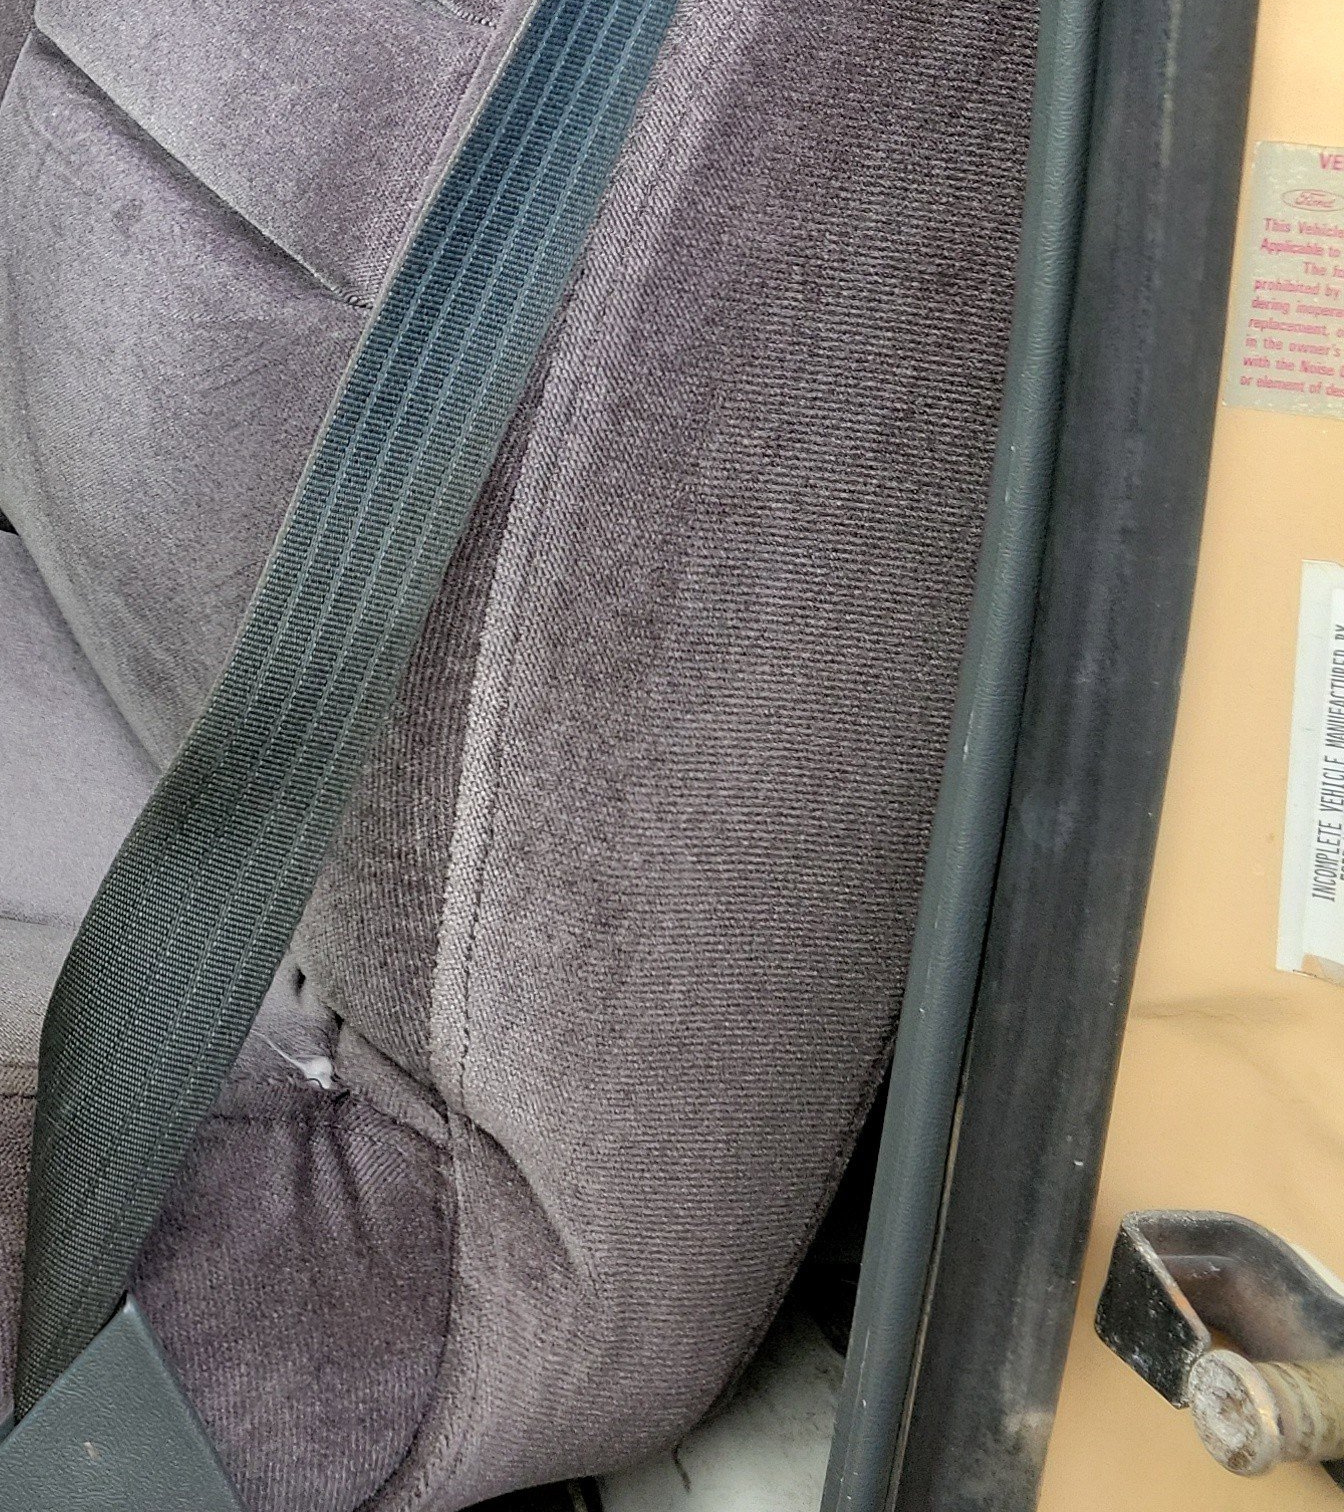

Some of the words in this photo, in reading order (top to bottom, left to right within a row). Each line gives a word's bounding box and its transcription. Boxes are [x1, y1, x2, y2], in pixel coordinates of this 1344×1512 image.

[1263, 217, 1291, 233] This
[1260, 237, 1324, 256] Applicable
[1243, 355, 1271, 369] with
[1319, 755, 1344, 812] VEHICLE
[1312, 820, 1343, 903] INCOMPLETE
